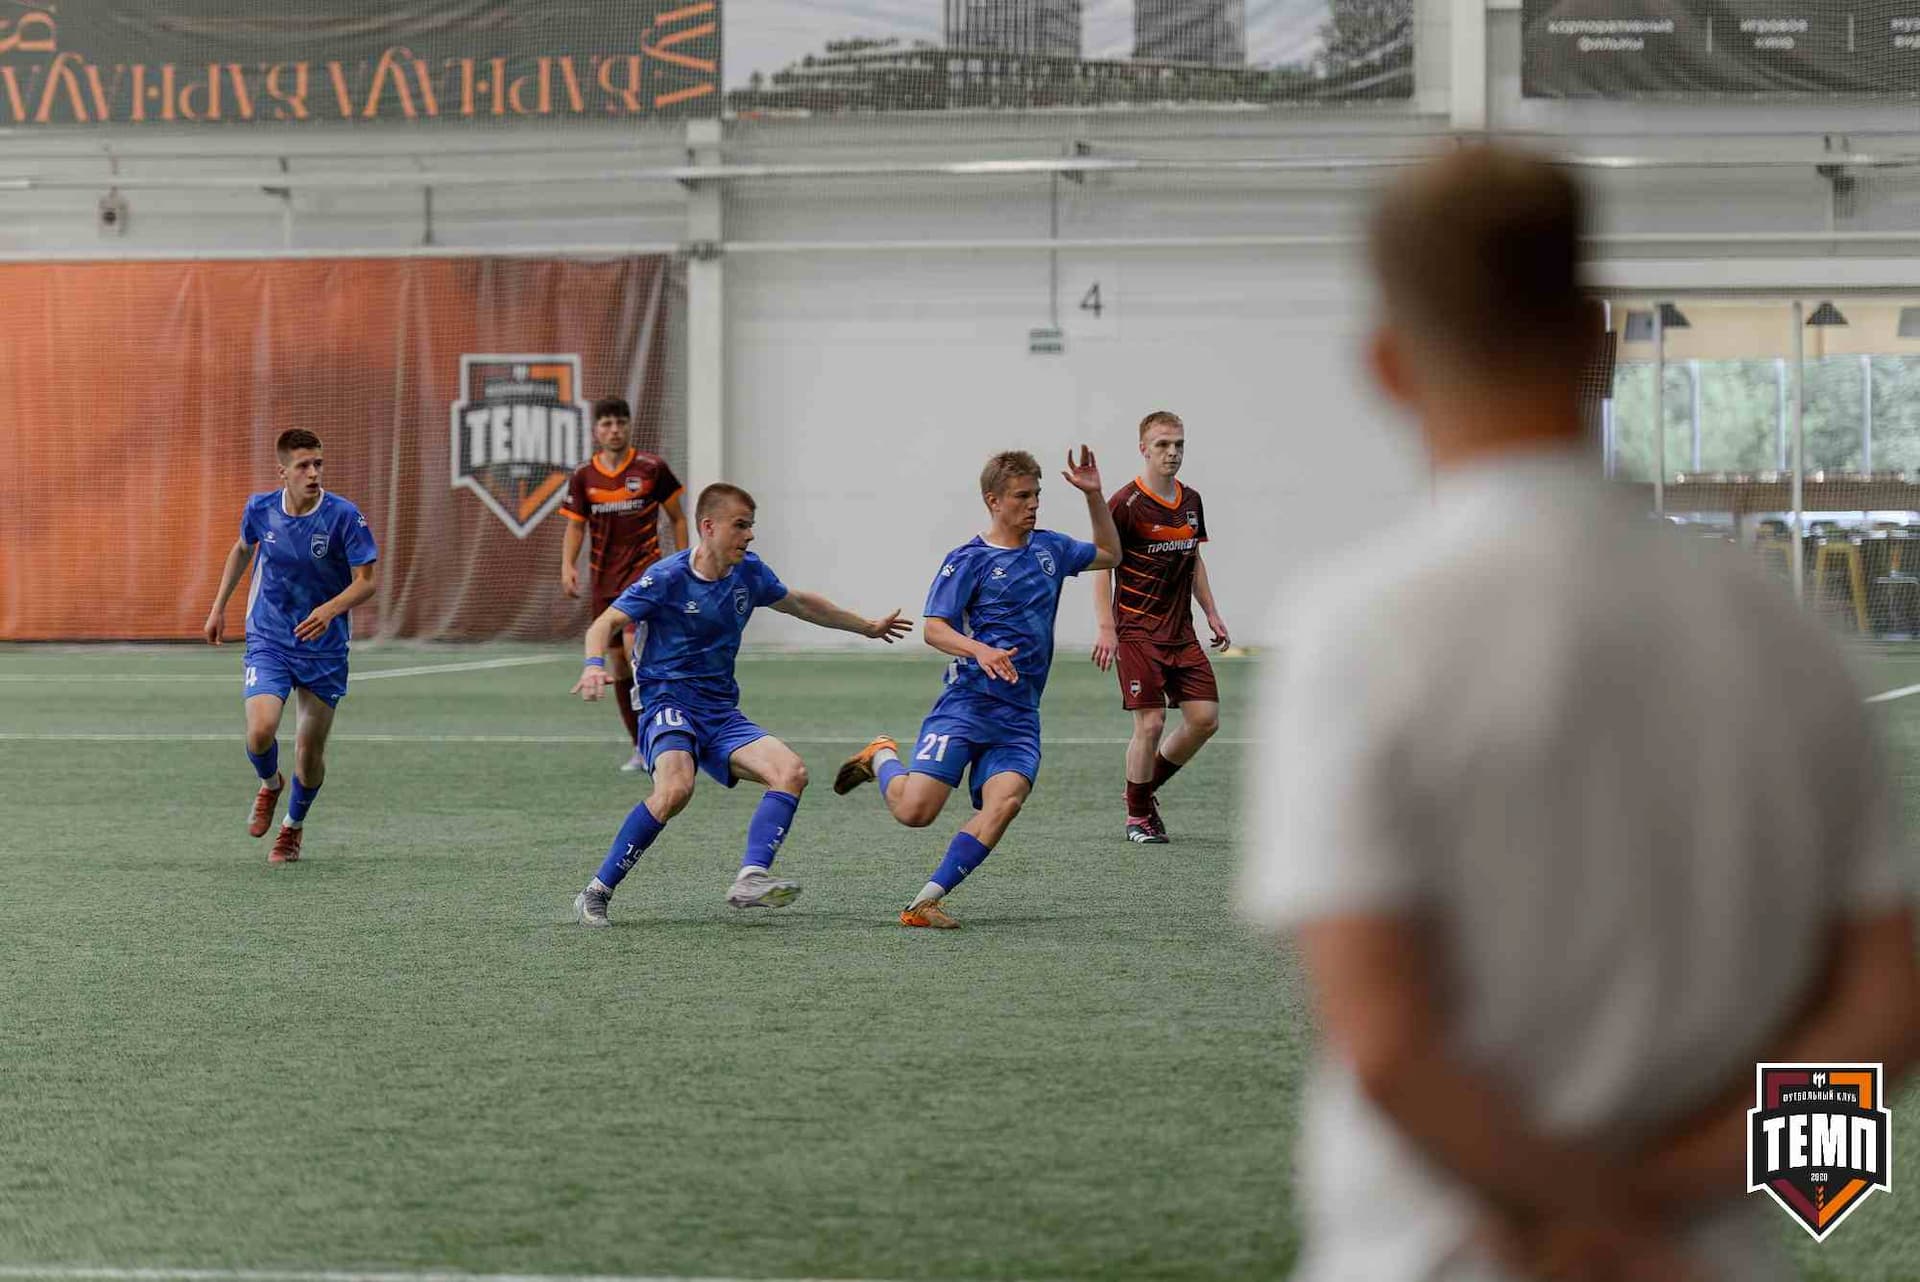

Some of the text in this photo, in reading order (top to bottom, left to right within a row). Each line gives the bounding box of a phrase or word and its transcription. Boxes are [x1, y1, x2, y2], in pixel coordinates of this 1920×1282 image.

[1079, 281, 1104, 319] 4
[465, 404, 577, 469] ТЕМП
[655, 708, 684, 727] 10
[916, 733, 950, 762] 21
